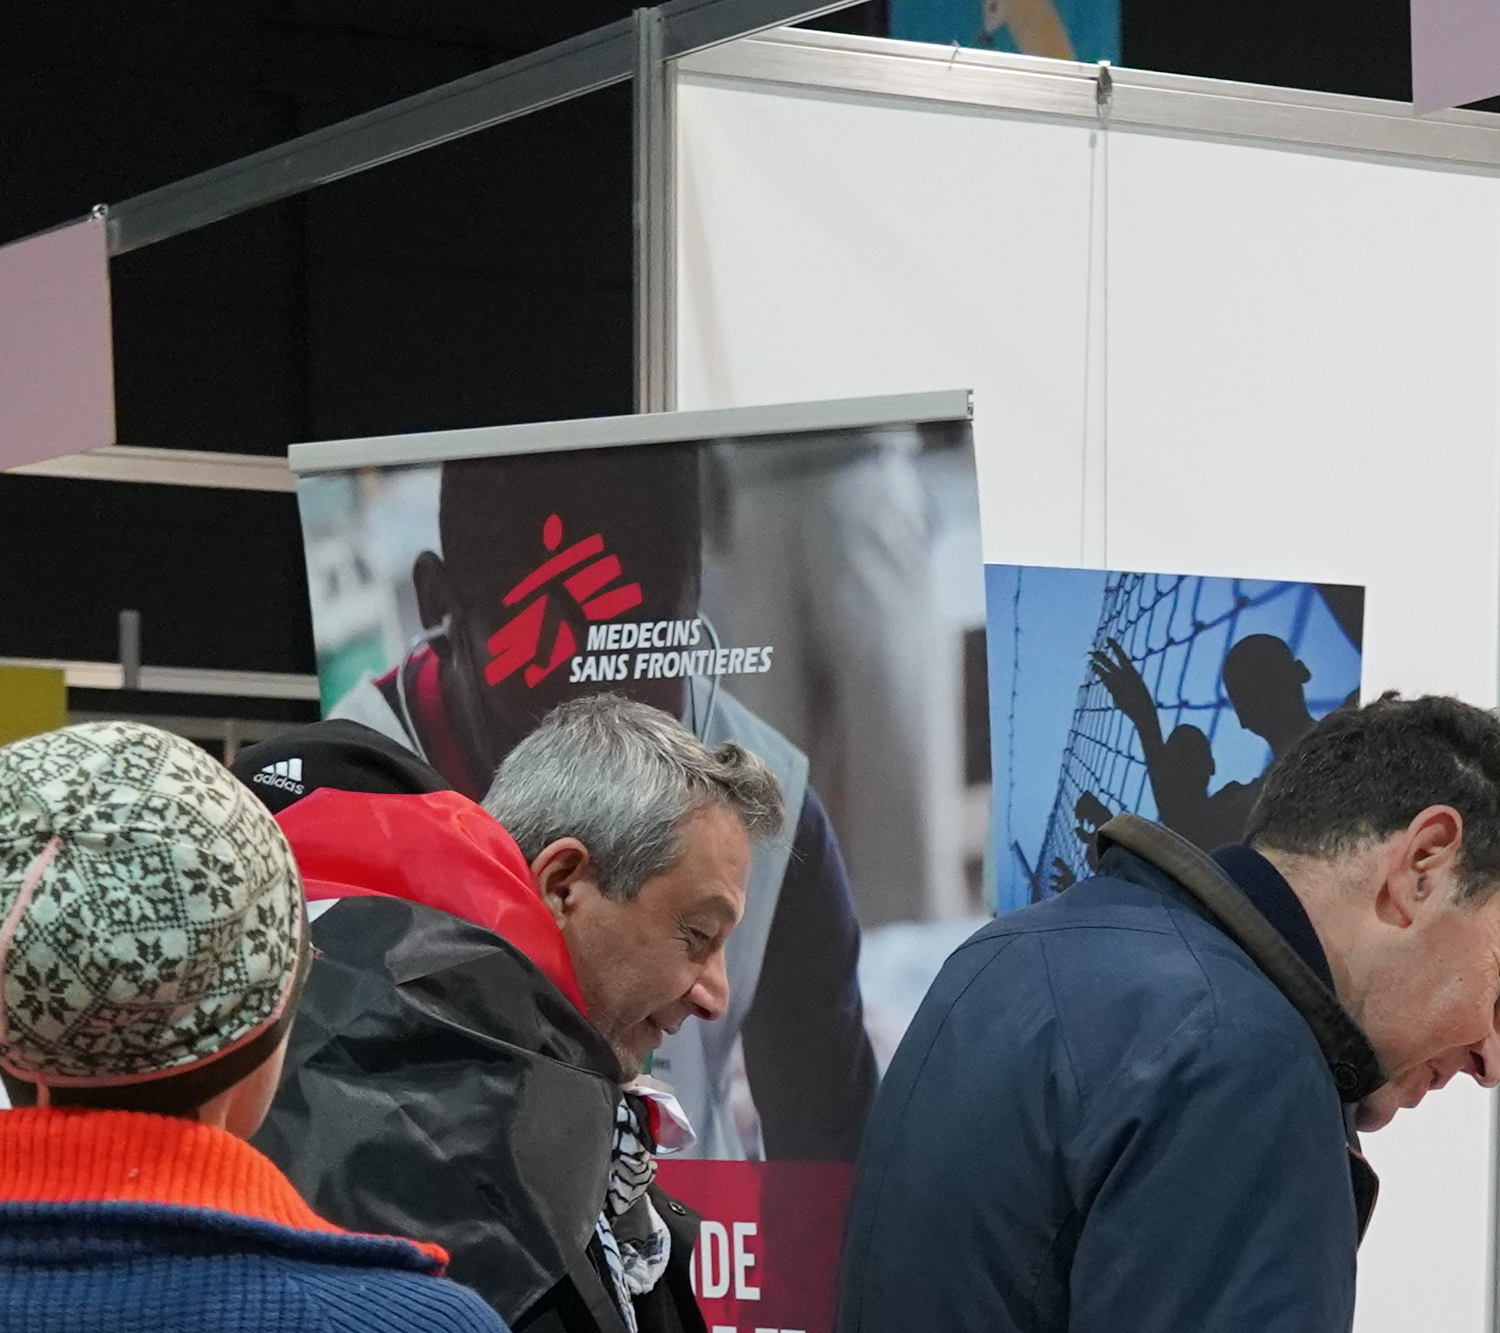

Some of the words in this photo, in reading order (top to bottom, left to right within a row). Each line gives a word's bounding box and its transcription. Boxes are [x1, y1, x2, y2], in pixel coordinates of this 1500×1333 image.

[586, 619, 702, 651] MEDECINS
[569, 653, 628, 683] SANS
[633, 646, 774, 680] FRONTIERES
[253, 772, 305, 795] adidas
[689, 1220, 760, 1300] DE
